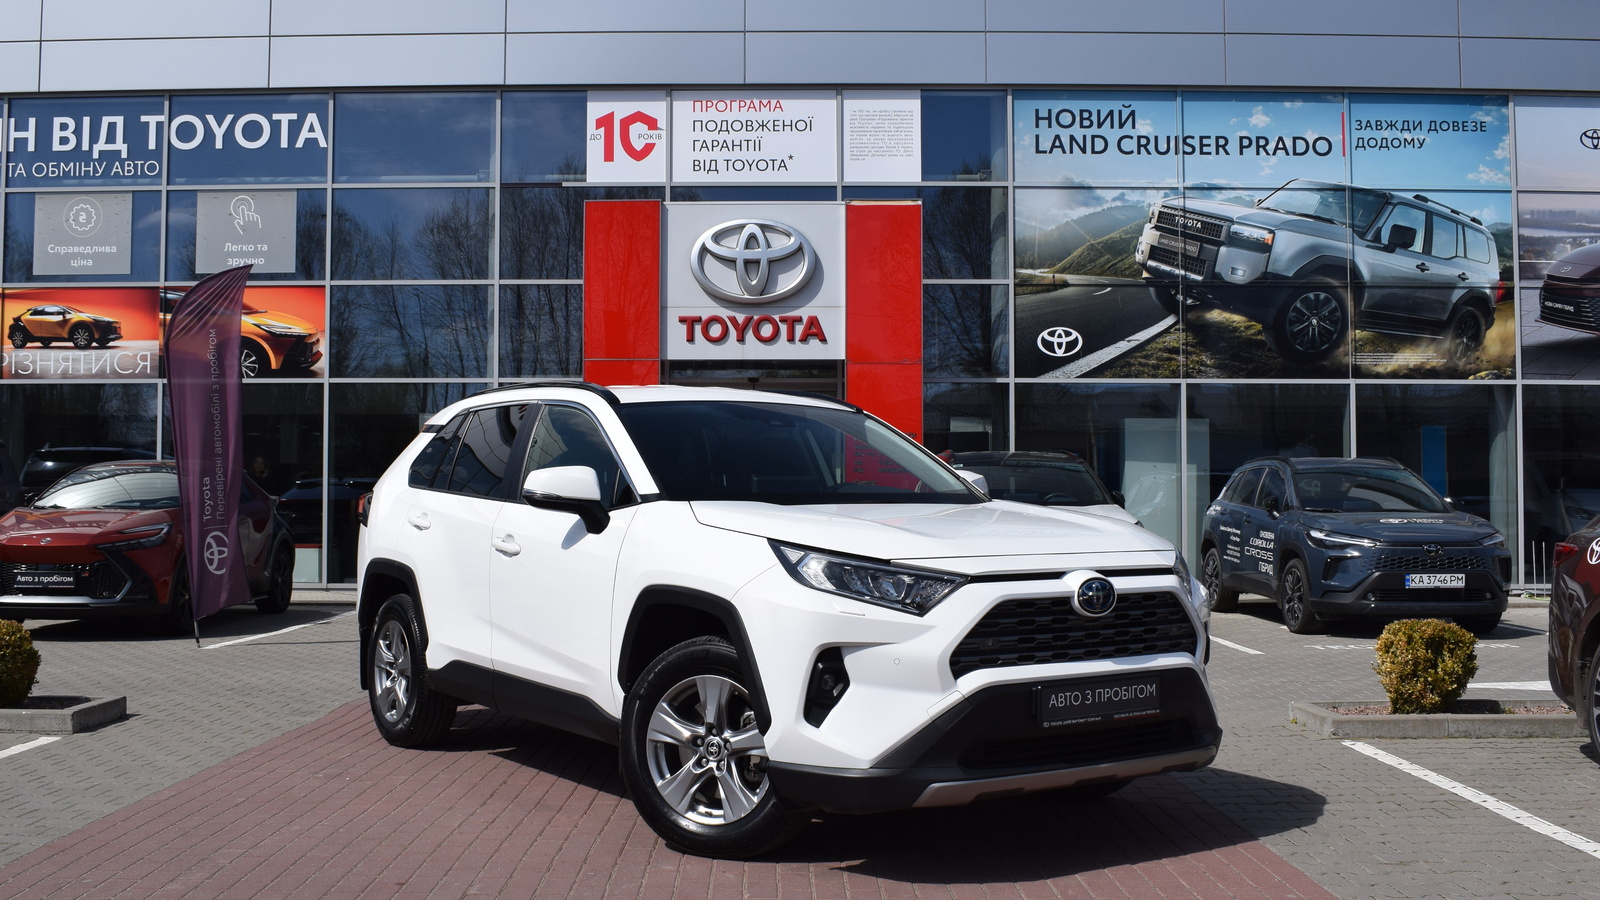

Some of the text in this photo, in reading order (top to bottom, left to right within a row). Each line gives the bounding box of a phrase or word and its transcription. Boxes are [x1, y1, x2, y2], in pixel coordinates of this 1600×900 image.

[692, 99, 784, 113] ПРОГРАМА
[1034, 103, 1136, 130] НОВИЙ
[692, 116, 814, 135] ПОДОВЖЕНОЇ
[1354, 119, 1487, 134] ЗАВЖДИ ДОВЕЗЕ
[0, 112, 328, 159] Н ВІД TOYOTA
[589, 133, 602, 141] ДО
[595, 110, 658, 162] 10
[692, 136, 763, 152] ГАРАНТІЇ
[1035, 134, 1333, 157] LAND CRUISER PRADO
[1354, 137, 1426, 151] ДОДОМУ
[6, 160, 160, 178] ТА ОБМІНУ АВТО
[692, 159, 719, 174] ВІД
[1175, 217, 1202, 228] TOYOTA
[47, 243, 117, 254] Справедлива
[223, 242, 268, 252] Легко та
[70, 257, 93, 267] ціна
[226, 256, 265, 267] зручно
[678, 315, 827, 344] TOYOTA
[207, 328, 220, 382] пробігом
[210, 393, 222, 454] автомобілі
[213, 457, 226, 520] Перевірені
[202, 476, 214, 522] Toyota
[1249, 537, 1275, 550] COROLLA
[1244, 546, 1274, 561] CROSS
[16, 574, 33, 582] Авто
[40, 574, 73, 583] пробігом
[1410, 575, 1464, 585] KA 3746 PM
[1048, 683, 1156, 708] АВТО З ПРОБІГОМ
